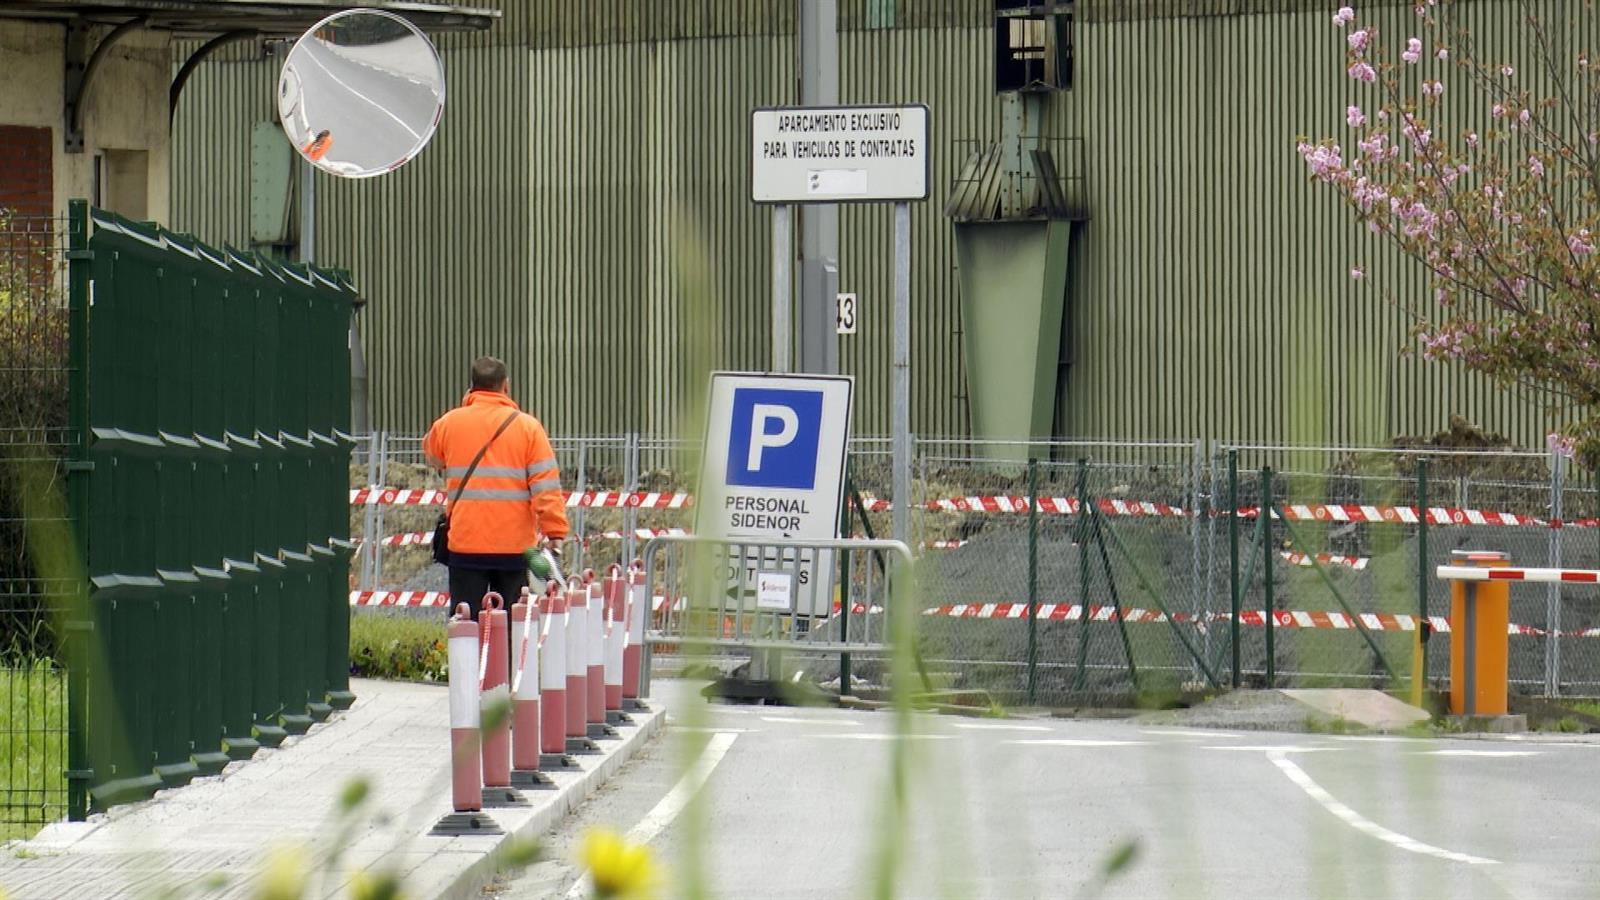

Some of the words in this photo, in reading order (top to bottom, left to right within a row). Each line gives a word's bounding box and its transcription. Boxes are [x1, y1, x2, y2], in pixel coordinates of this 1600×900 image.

[778, 114, 847, 133] APARCAMIENTO
[851, 112, 901, 131] EXCLUSIVO
[763, 141, 788, 158] PARA
[792, 140, 841, 158] VEHICULOS
[845, 140, 856, 158] DE
[860, 139, 915, 158] CONTRATAS
[747, 403, 799, 471] P
[725, 496, 810, 514] PERSONAL
[731, 513, 801, 531] SIDENOR
